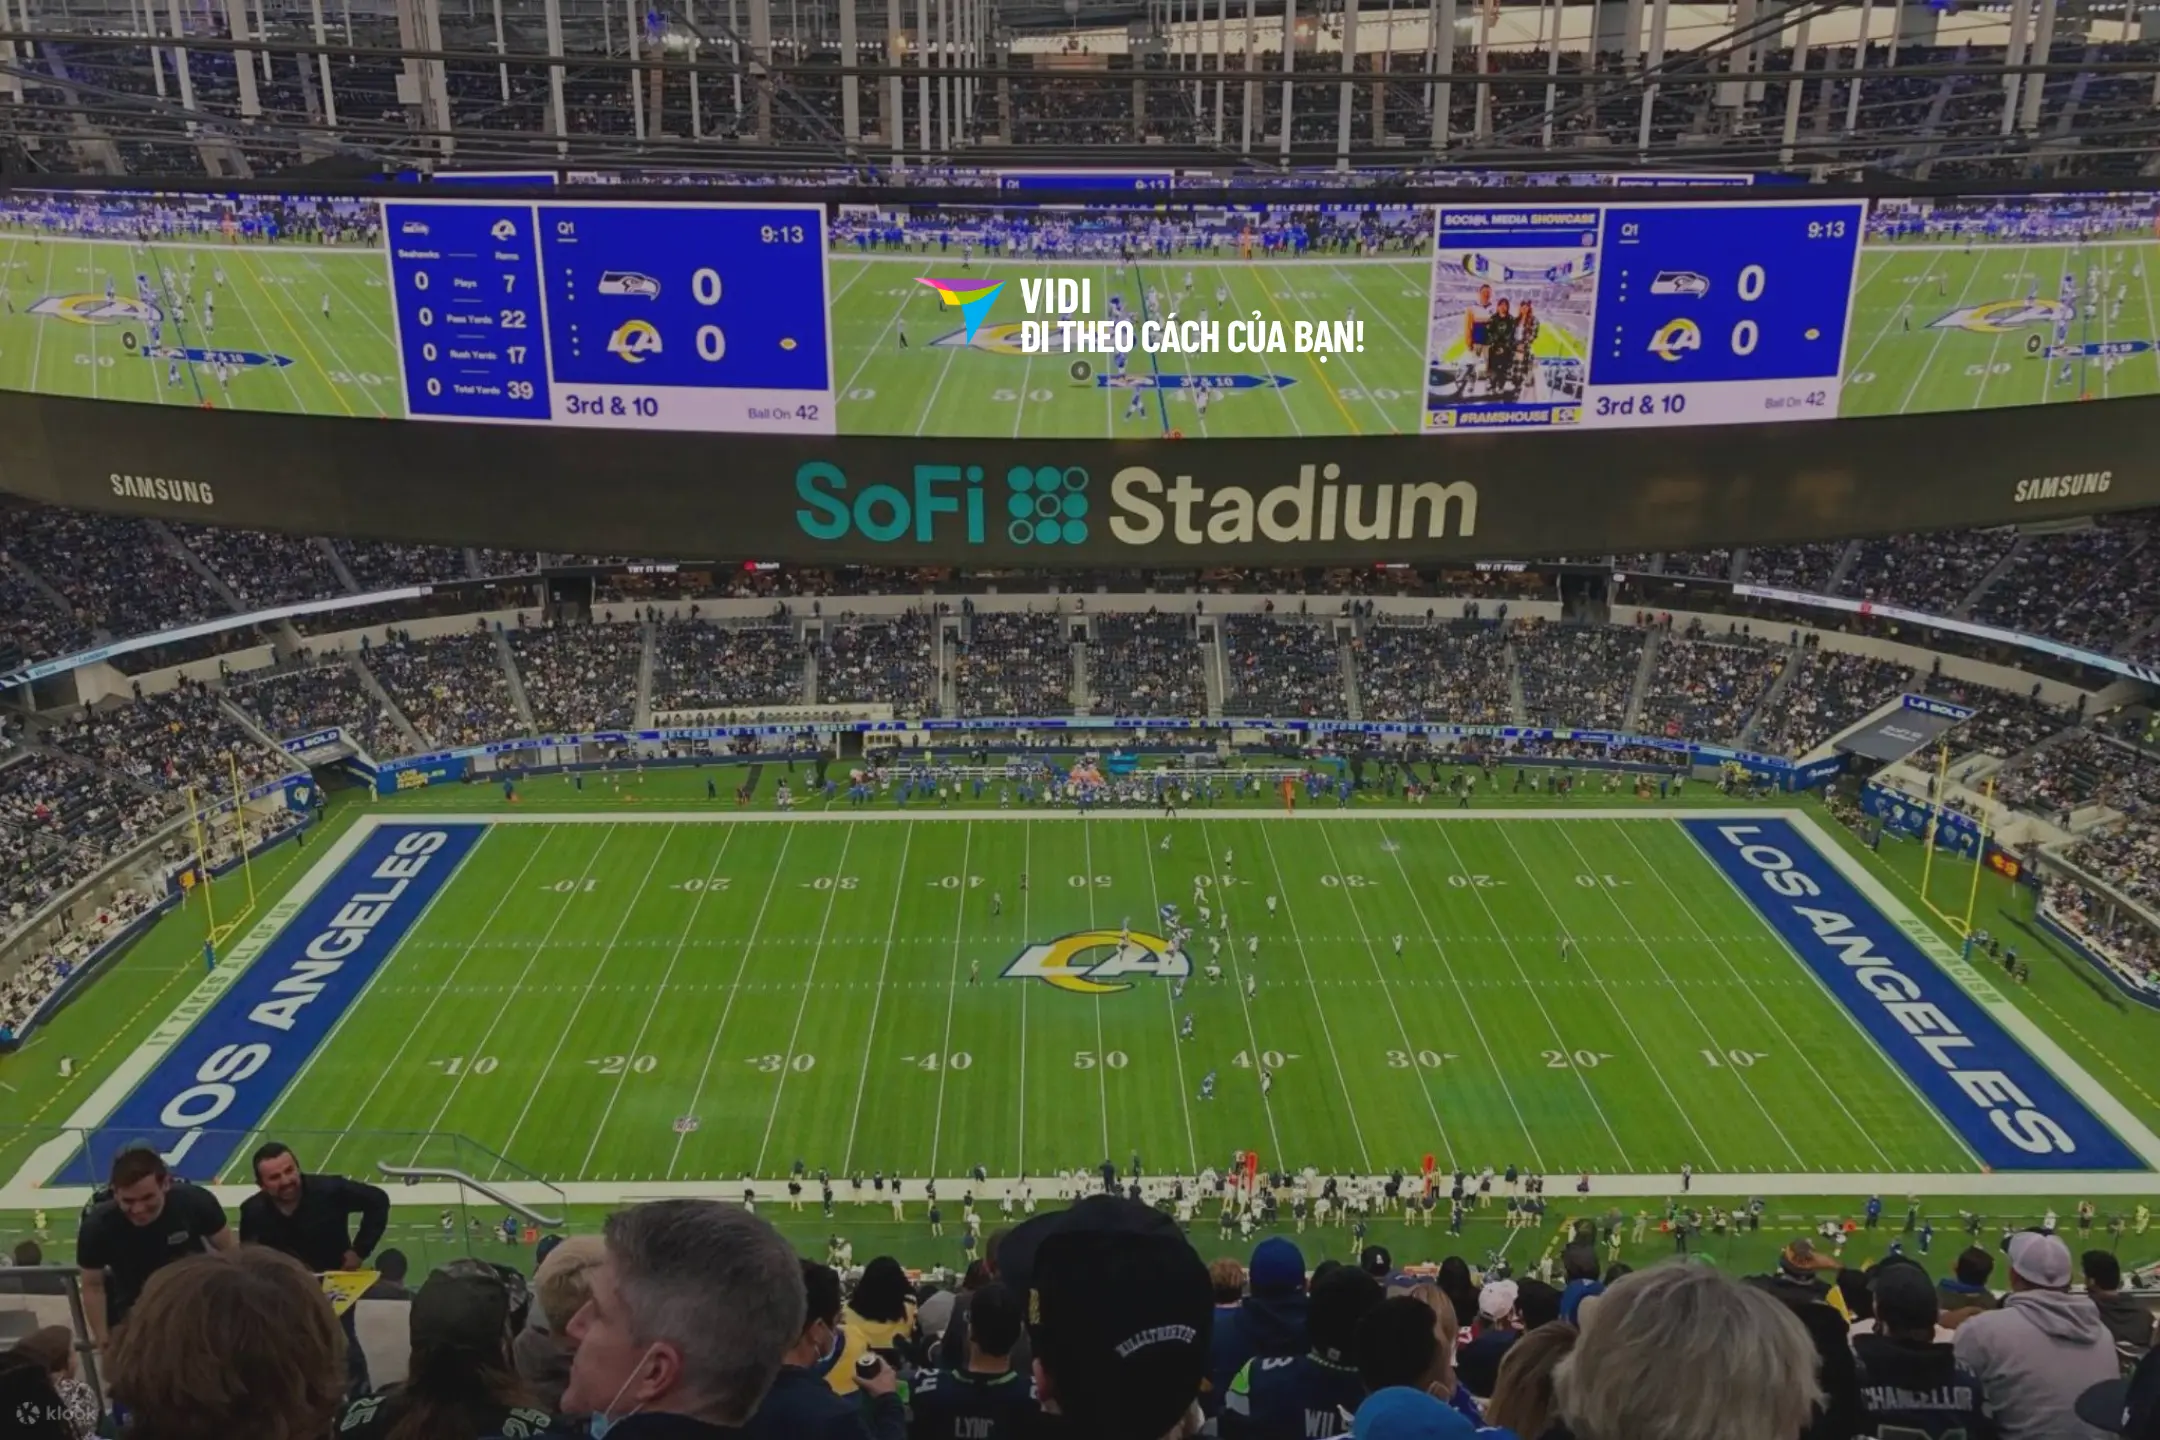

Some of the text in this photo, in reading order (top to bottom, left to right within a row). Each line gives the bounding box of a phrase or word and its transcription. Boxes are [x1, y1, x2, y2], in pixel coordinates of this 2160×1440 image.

[1491, 213, 1528, 225] MEDIA
[1530, 212, 1596, 225] SHOWCASE
[557, 221, 575, 236] Q1
[760, 225, 805, 244] 9:13
[1621, 223, 1640, 237] Q1
[1806, 221, 1846, 239] 9:13
[397, 249, 441, 260] Seahawks
[414, 270, 516, 293] 0 Plays 7
[692, 267, 722, 306] 0
[1737, 264, 1767, 302] 0
[418, 307, 433, 327] 0
[467, 314, 493, 325] Yards
[500, 309, 527, 329] 22
[695, 324, 727, 362] 0
[1731, 319, 1759, 355] 0
[422, 342, 438, 362] 0
[472, 350, 498, 361] Yards
[506, 346, 527, 365] 17
[427, 377, 534, 400] 0 Total Yards 39
[1805, 389, 1827, 407] 42
[566, 394, 659, 417] 3rd & 10
[748, 404, 819, 421] Ball On 42
[1596, 393, 1687, 416] 3rd & 10
[1459, 409, 1550, 425] #RAMSHOUSE
[109, 473, 215, 505] SAMSUNG
[2014, 470, 2112, 502] SAMSUNG
[796, 461, 1478, 545] SoFi Stadium
[1908, 698, 1928, 711] LA
[160, 830, 449, 1167] LOS ANGELES
[1717, 825, 2076, 1154] LOS ANGELES
[168, 976, 230, 1024] TAKES
[443, 1056, 499, 1075] 10
[597, 1055, 658, 1075] 20
[757, 1054, 816, 1073] 30
[917, 1052, 973, 1071] 40
[1073, 1051, 1129, 1070] 50
[1230, 1050, 1285, 1069] 40
[1386, 1050, 1443, 1068] 30
[1541, 1050, 1601, 1068] 20
[1700, 1049, 1757, 1067] 10
